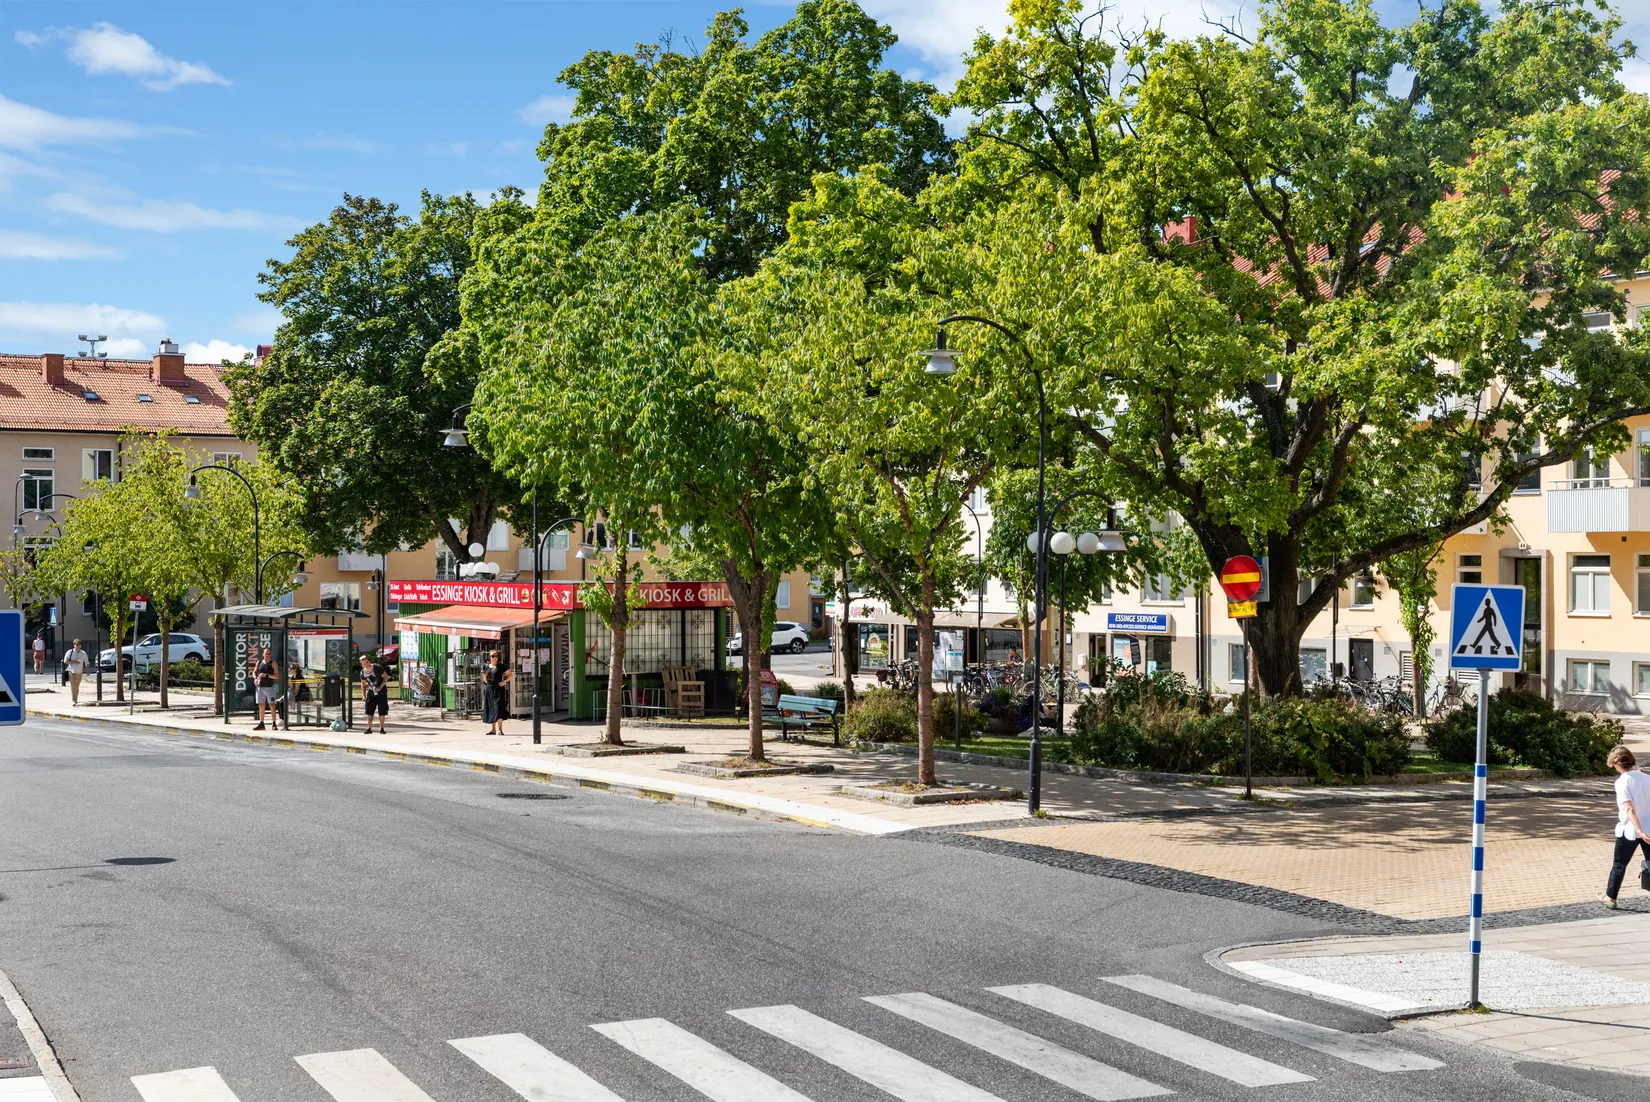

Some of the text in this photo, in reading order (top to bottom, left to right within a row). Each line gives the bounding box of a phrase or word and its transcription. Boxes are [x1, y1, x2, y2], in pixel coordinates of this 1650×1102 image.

[432, 585, 521, 604] ESSINGE KIOSK & GRILL
[640, 588, 681, 602] KIOSK
[684, 588, 695, 602] &
[1115, 614, 1158, 623] ESSINGE SERVICE
[235, 633, 247, 691] DOKTOR
[561, 632, 569, 702] VITAMIN WELL
